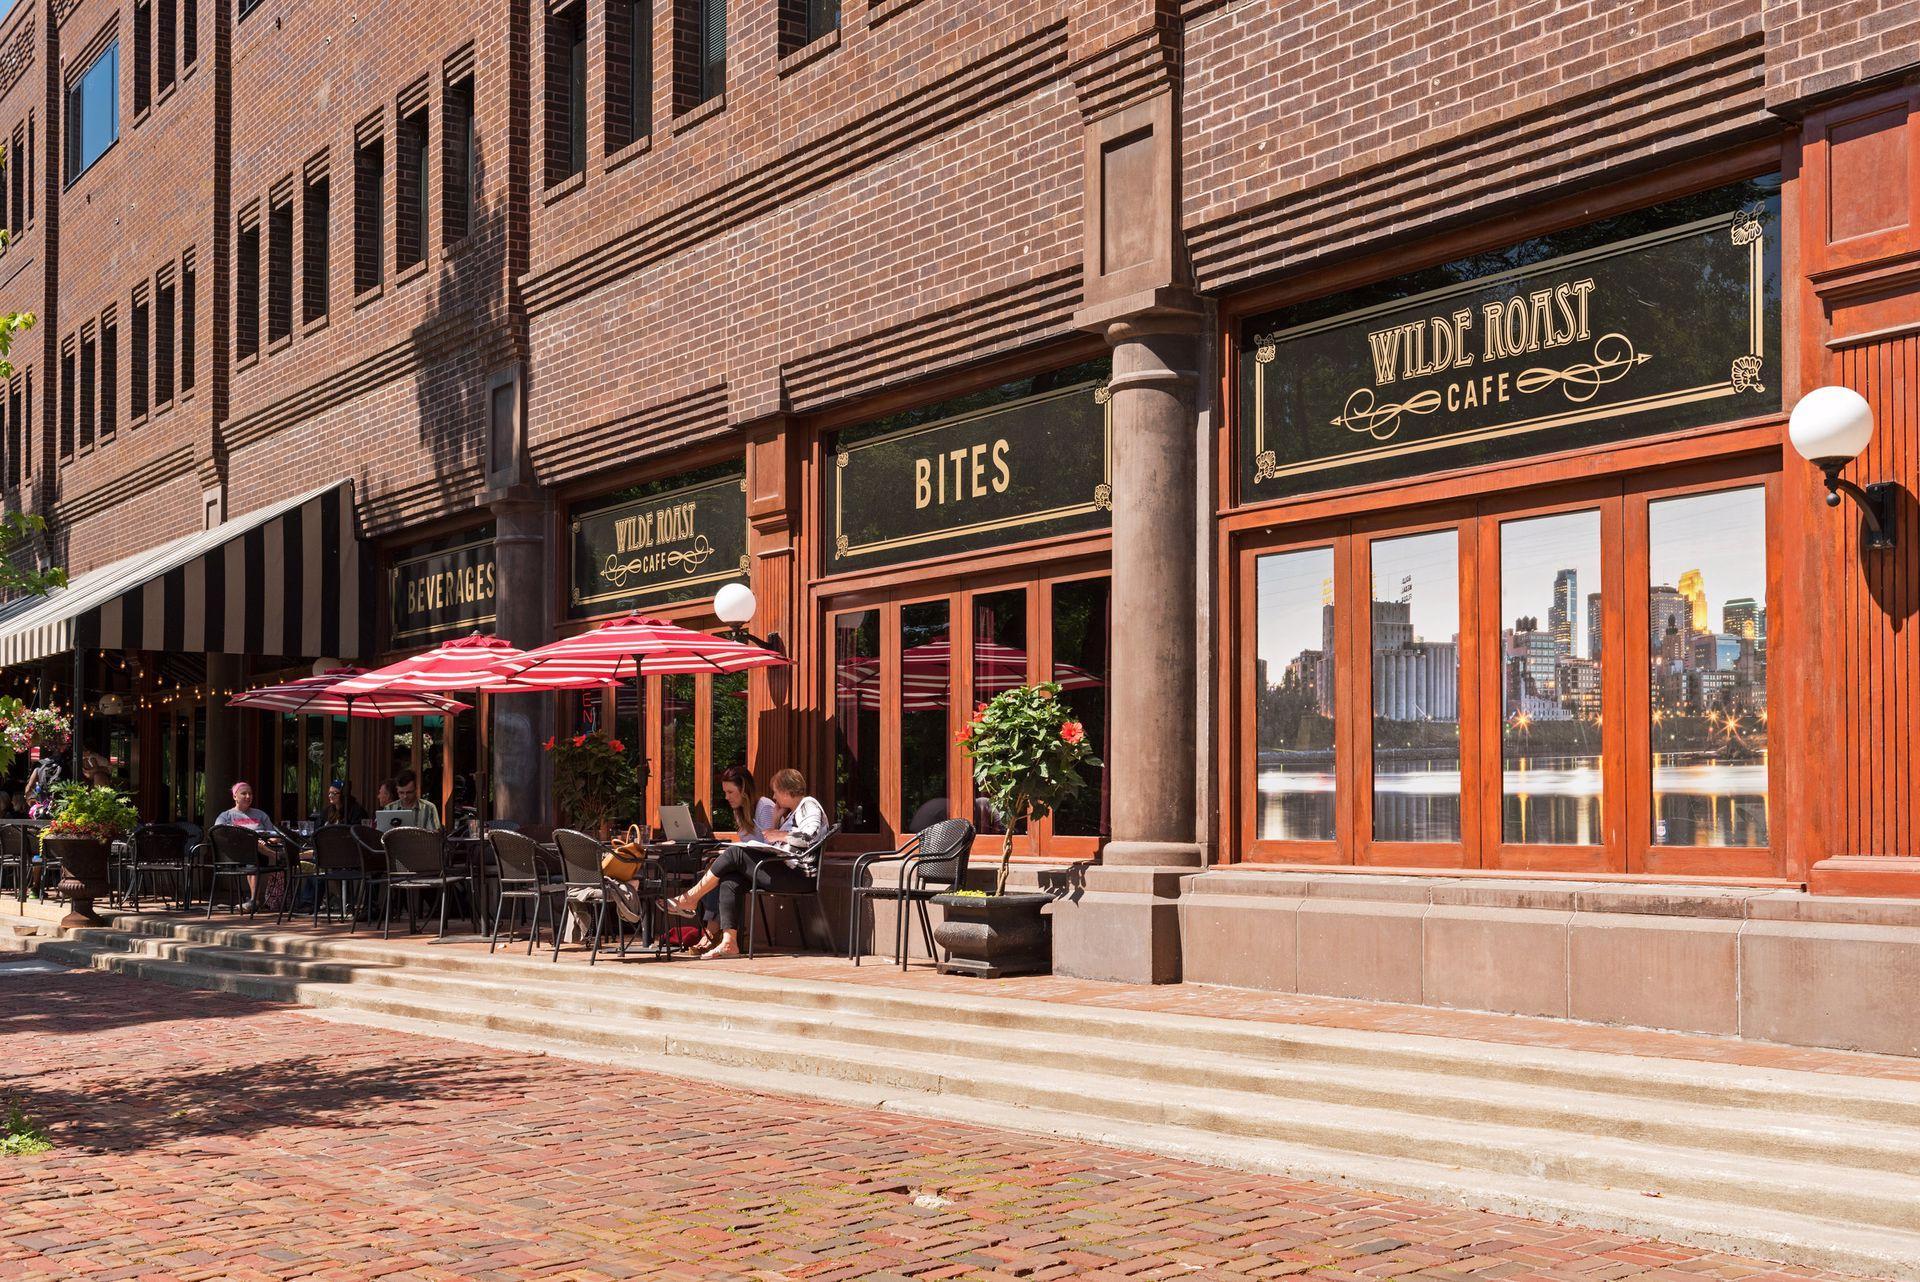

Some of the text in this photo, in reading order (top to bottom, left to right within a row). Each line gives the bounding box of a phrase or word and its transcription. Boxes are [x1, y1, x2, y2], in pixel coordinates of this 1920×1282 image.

[1368, 278, 1595, 386] WILDE ROAST
[1447, 372, 1510, 412] CAFE
[915, 438, 1010, 510] BITES
[615, 501, 697, 554] WILDE ROAST
[407, 561, 496, 614] BEVERAGES
[642, 551, 667, 573] CAFE
